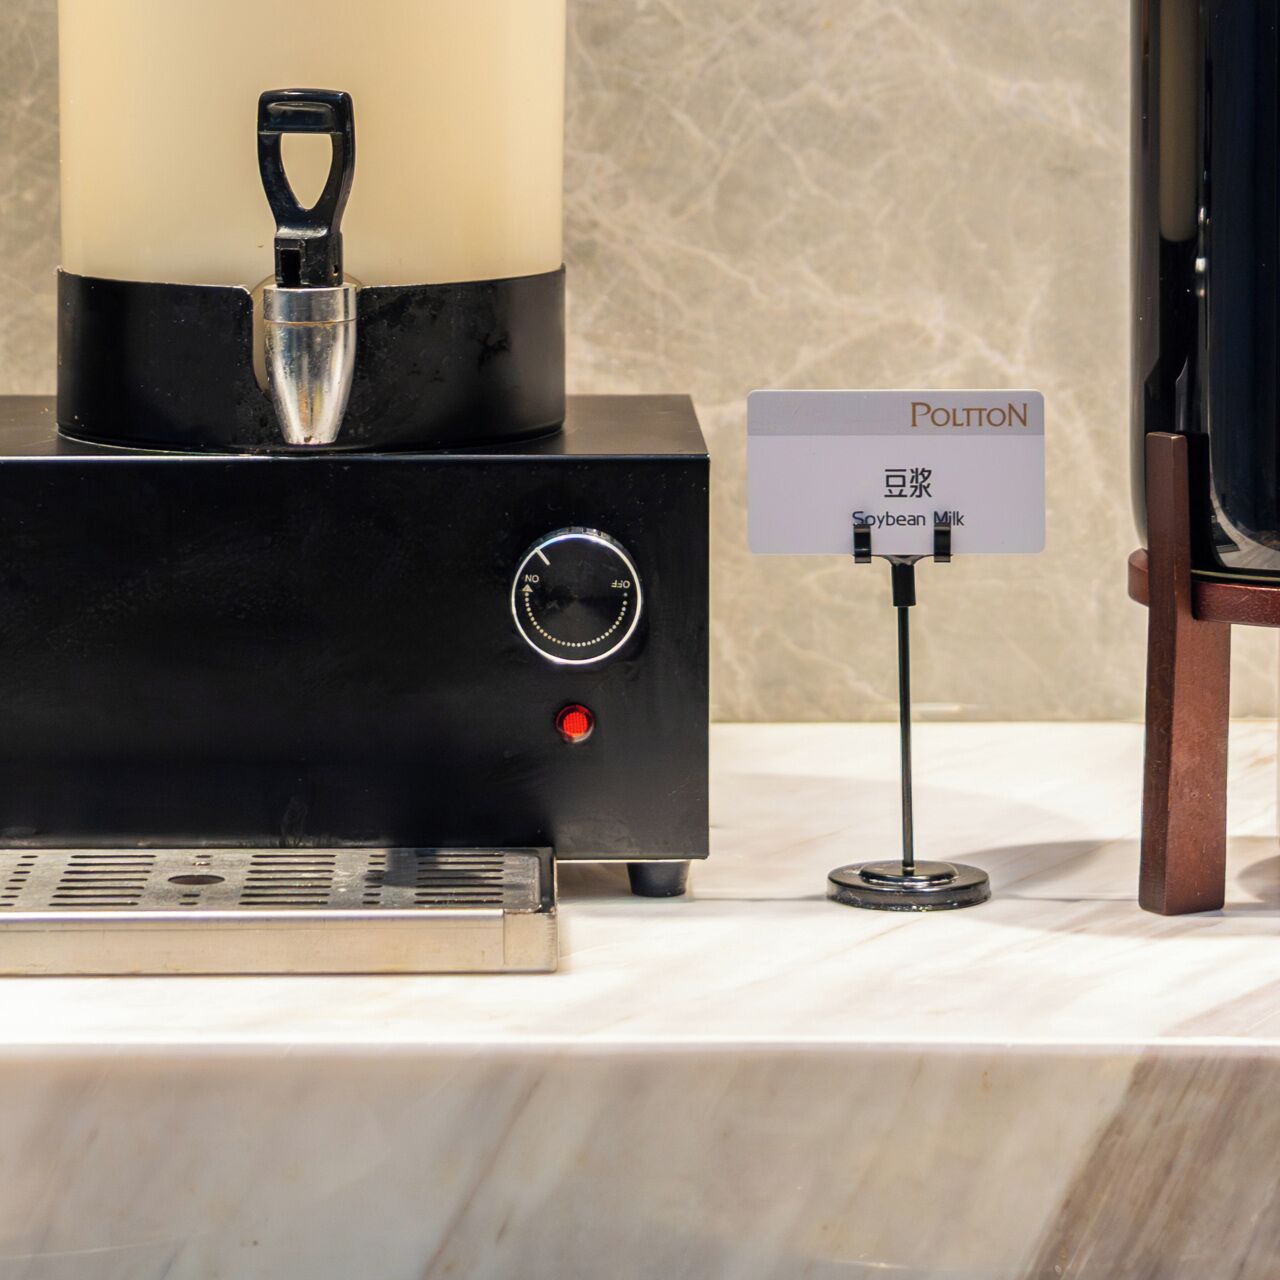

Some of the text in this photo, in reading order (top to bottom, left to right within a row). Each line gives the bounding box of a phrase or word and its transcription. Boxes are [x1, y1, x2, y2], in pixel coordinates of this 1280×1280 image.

[911, 401, 1028, 427] POLTTON
[884, 467, 932, 498] 豆浆
[852, 511, 964, 528] Soybean Milk
[611, 579, 631, 589] OFF
